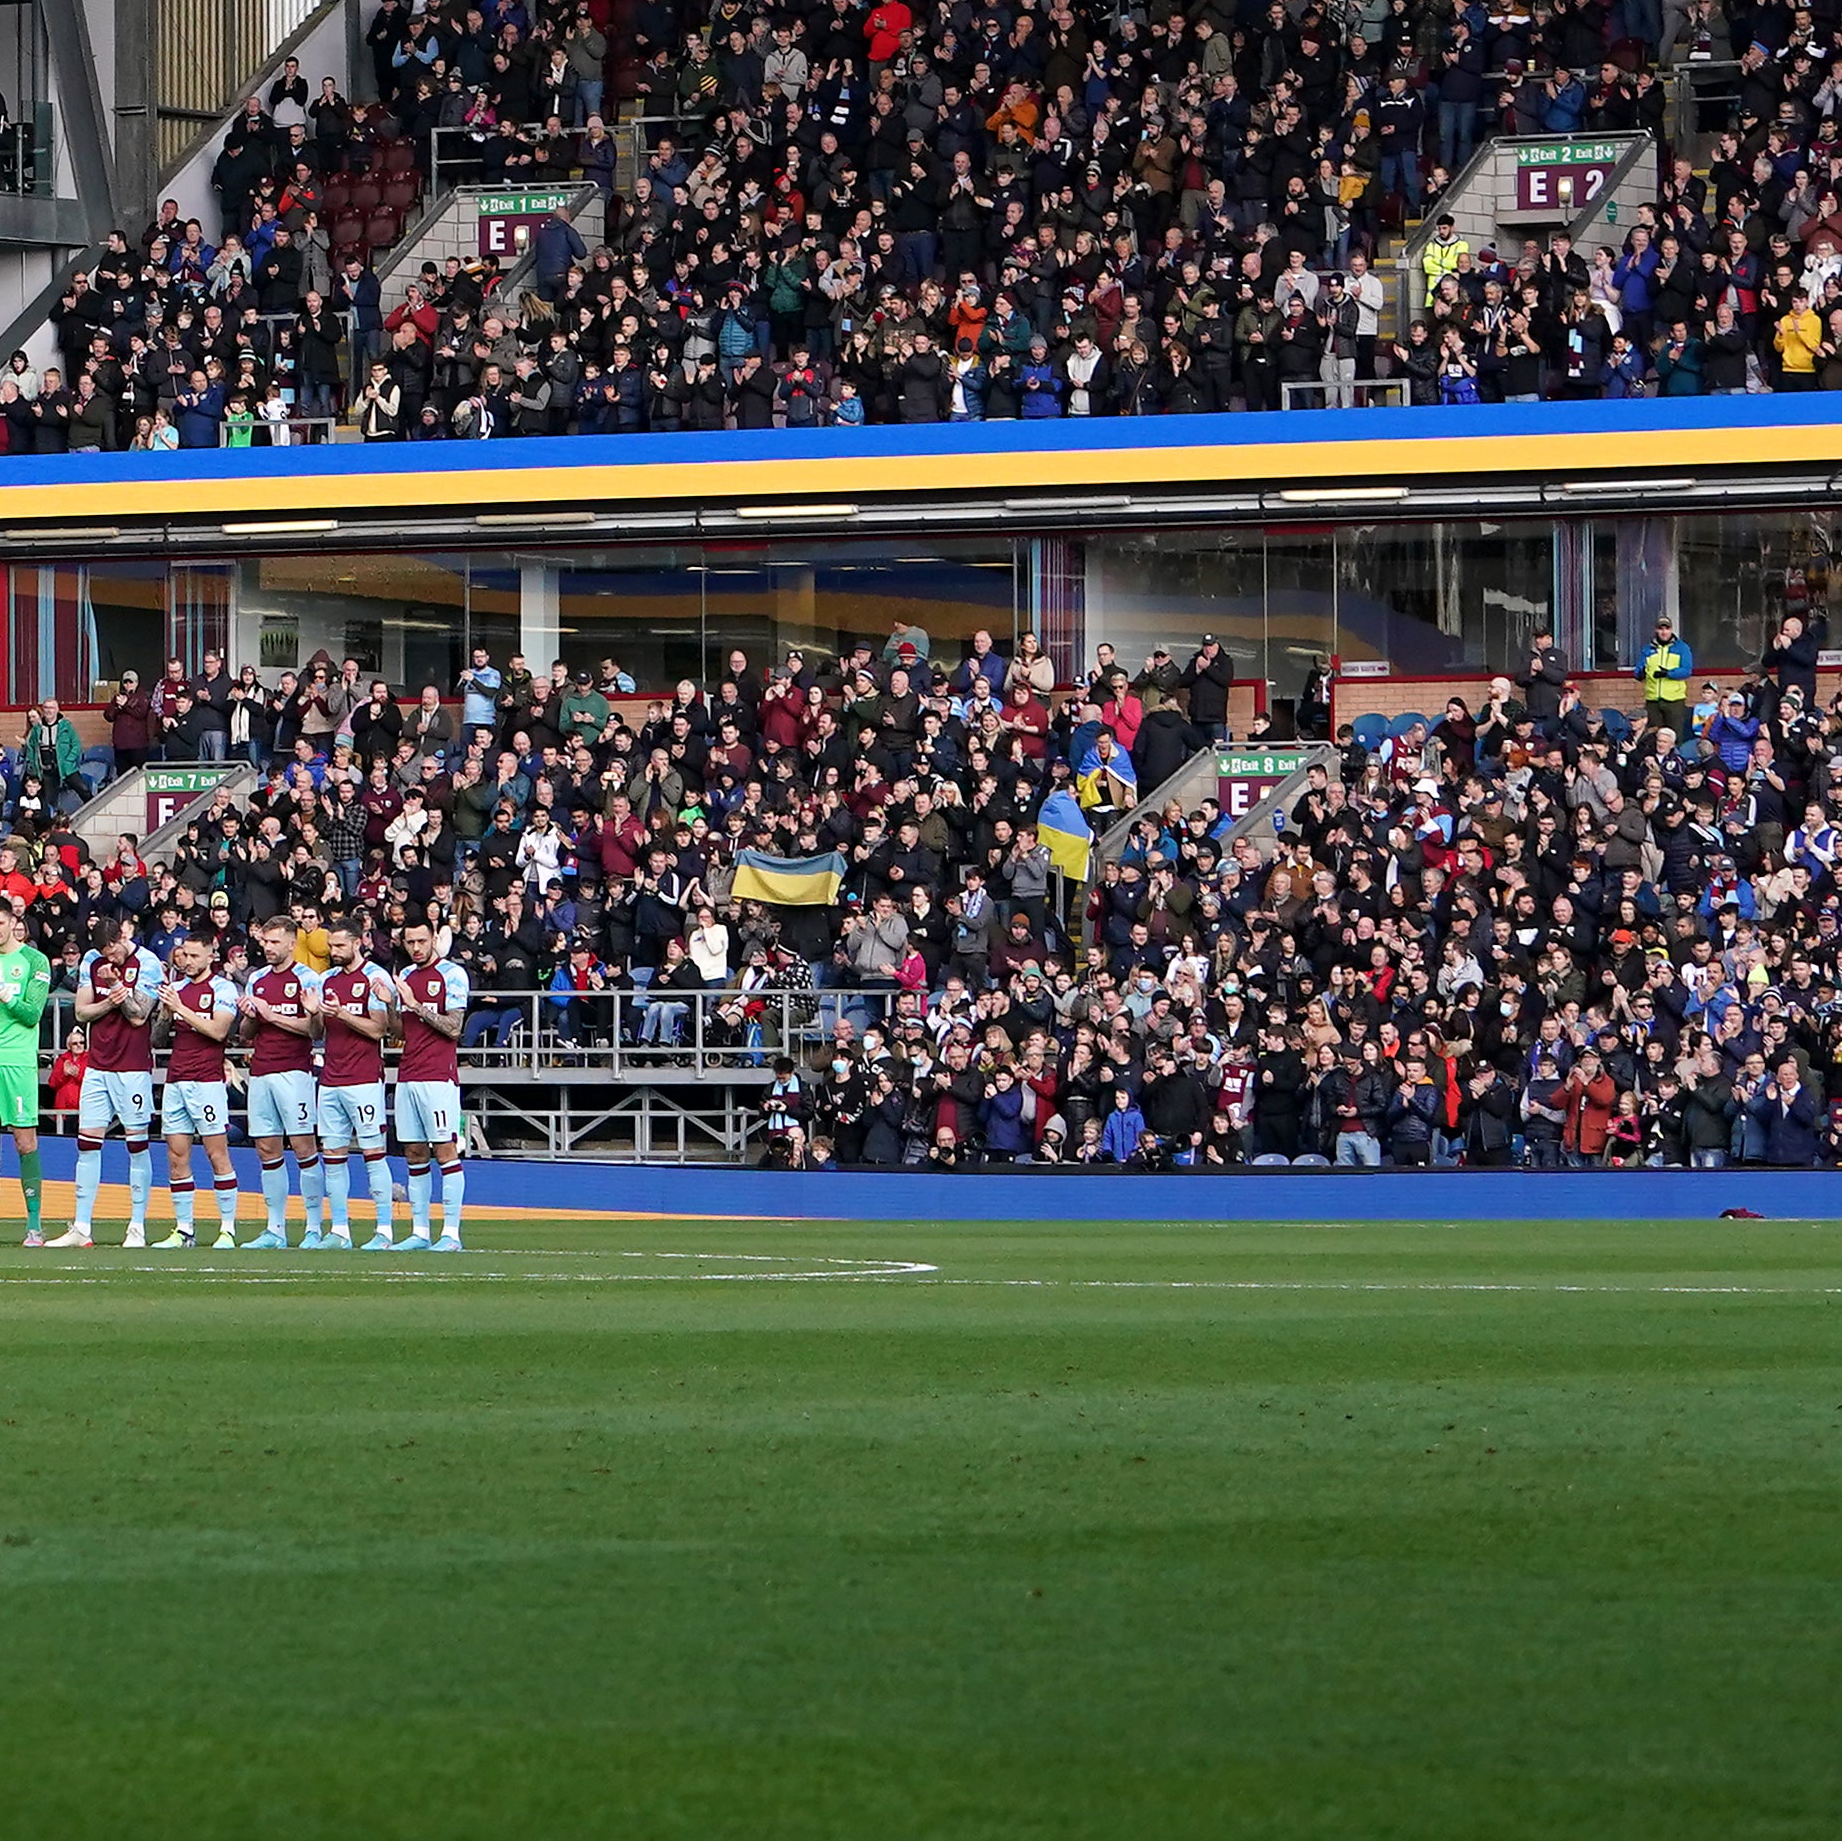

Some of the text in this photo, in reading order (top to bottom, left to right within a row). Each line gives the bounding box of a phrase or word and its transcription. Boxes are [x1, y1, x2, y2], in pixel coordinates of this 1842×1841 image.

[1562, 147, 1571, 162] 2
[1530, 172, 1547, 203] E
[520, 198, 526, 212] 1
[490, 221, 505, 250] E
[1241, 757, 1296, 773] Exit 8 Exit
[188, 774, 196, 788] 7
[1231, 783, 1248, 815] E
[16, 1096, 23, 1113] 1
[132, 1094, 143, 1111] 9
[204, 1105, 216, 1122] 8
[297, 1103, 308, 1121] 3
[357, 1105, 375, 1123] 19
[434, 1110, 447, 1128] 11
